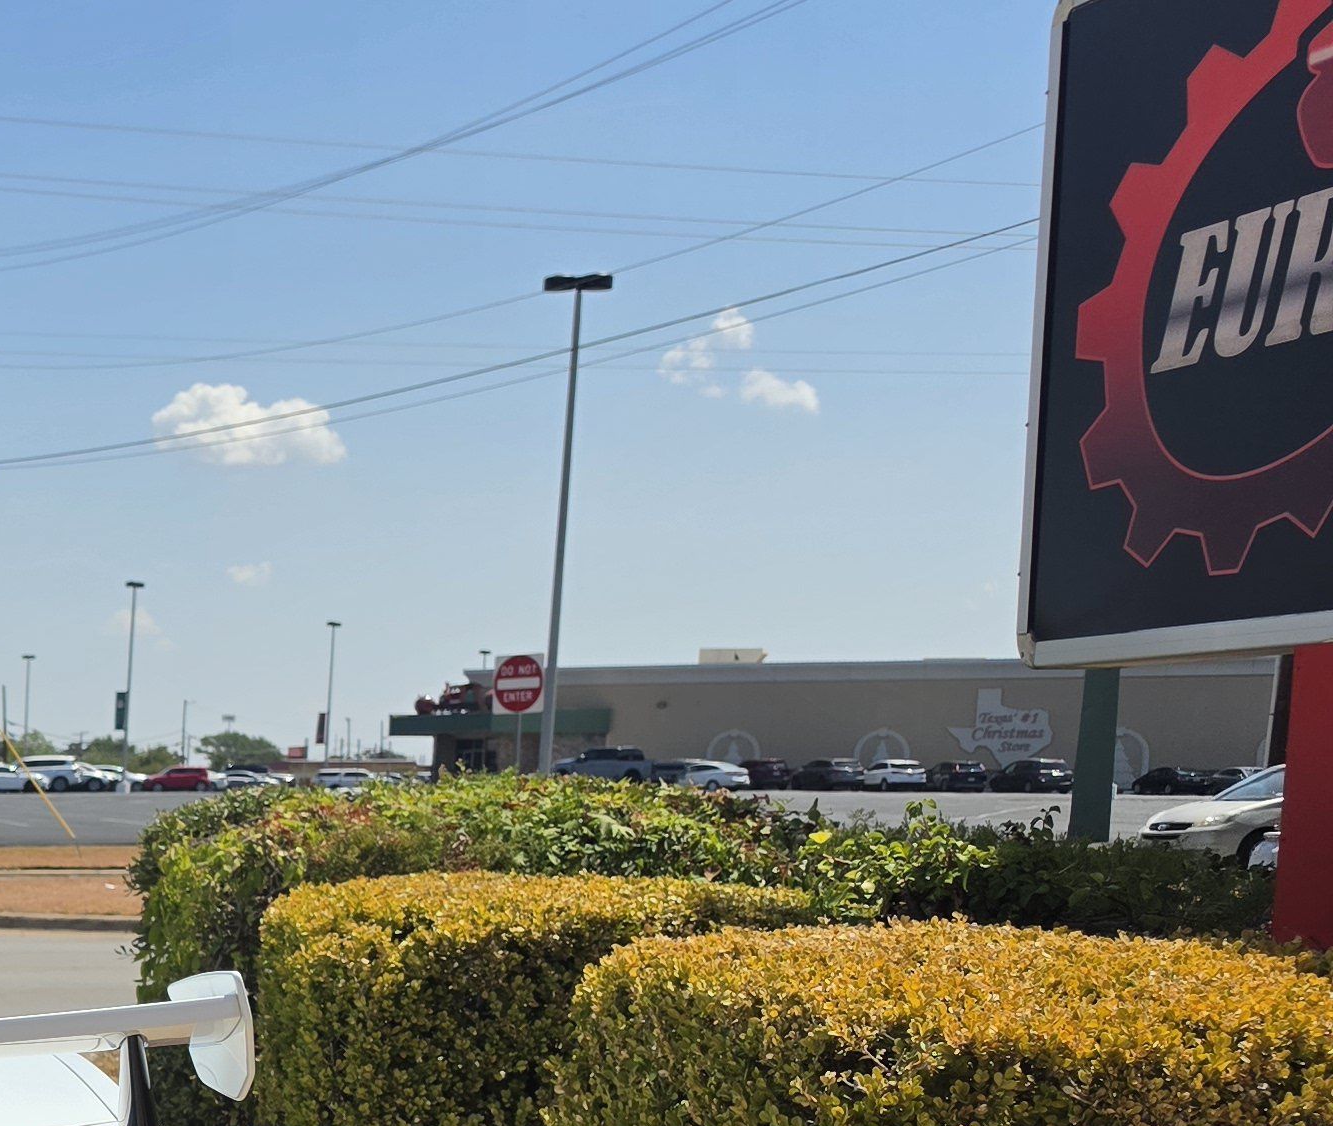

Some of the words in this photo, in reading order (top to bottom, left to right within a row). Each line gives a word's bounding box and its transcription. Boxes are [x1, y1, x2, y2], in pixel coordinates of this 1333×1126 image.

[501, 665, 514, 676] DO
[518, 664, 537, 675] NOT
[503, 691, 533, 702] ENTER
[1020, 713, 1039, 723] #1
[972, 727, 1044, 740] Christmas
[998, 741, 1031, 753] Store
